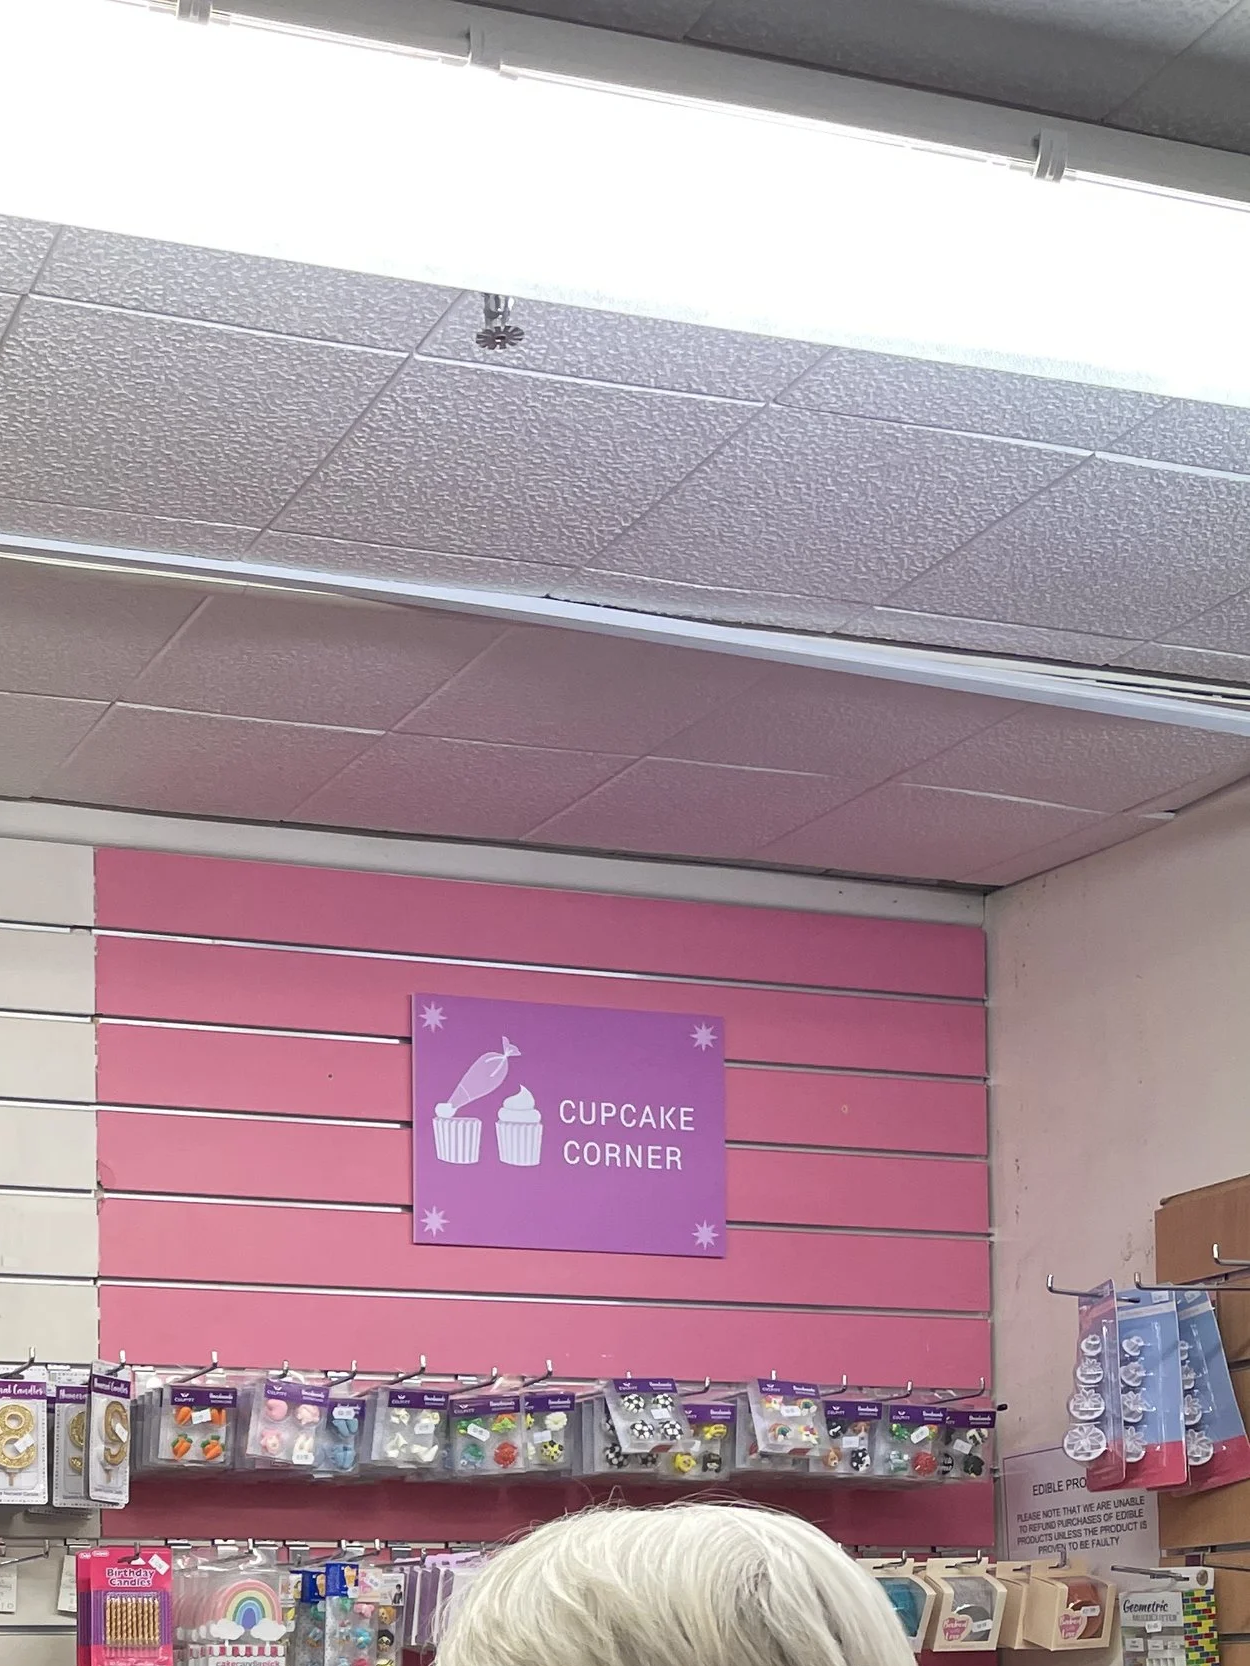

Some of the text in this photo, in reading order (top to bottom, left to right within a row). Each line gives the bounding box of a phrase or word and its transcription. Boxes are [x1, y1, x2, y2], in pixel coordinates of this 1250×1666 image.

[559, 1099, 695, 1131] CUPCAKE
[563, 1140, 682, 1170] CORNER
[1032, 1480, 1063, 1496] EDIBLE
[1017, 1495, 1145, 1523] PLEASE NOTE THAT WE ARE UNABLE
[1019, 1508, 1144, 1533] TO REFUND PURCHASES OF EDIBLE
[1017, 1520, 1147, 1545] PRODUCTS UNLESS THE PRODUCT IS
[1038, 1536, 1120, 1555] PROVEN TO BE FAULTY
[106, 1568, 156, 1580] Birthday
[109, 1578, 152, 1587] Candles
[1122, 1599, 1169, 1613] Geometric
